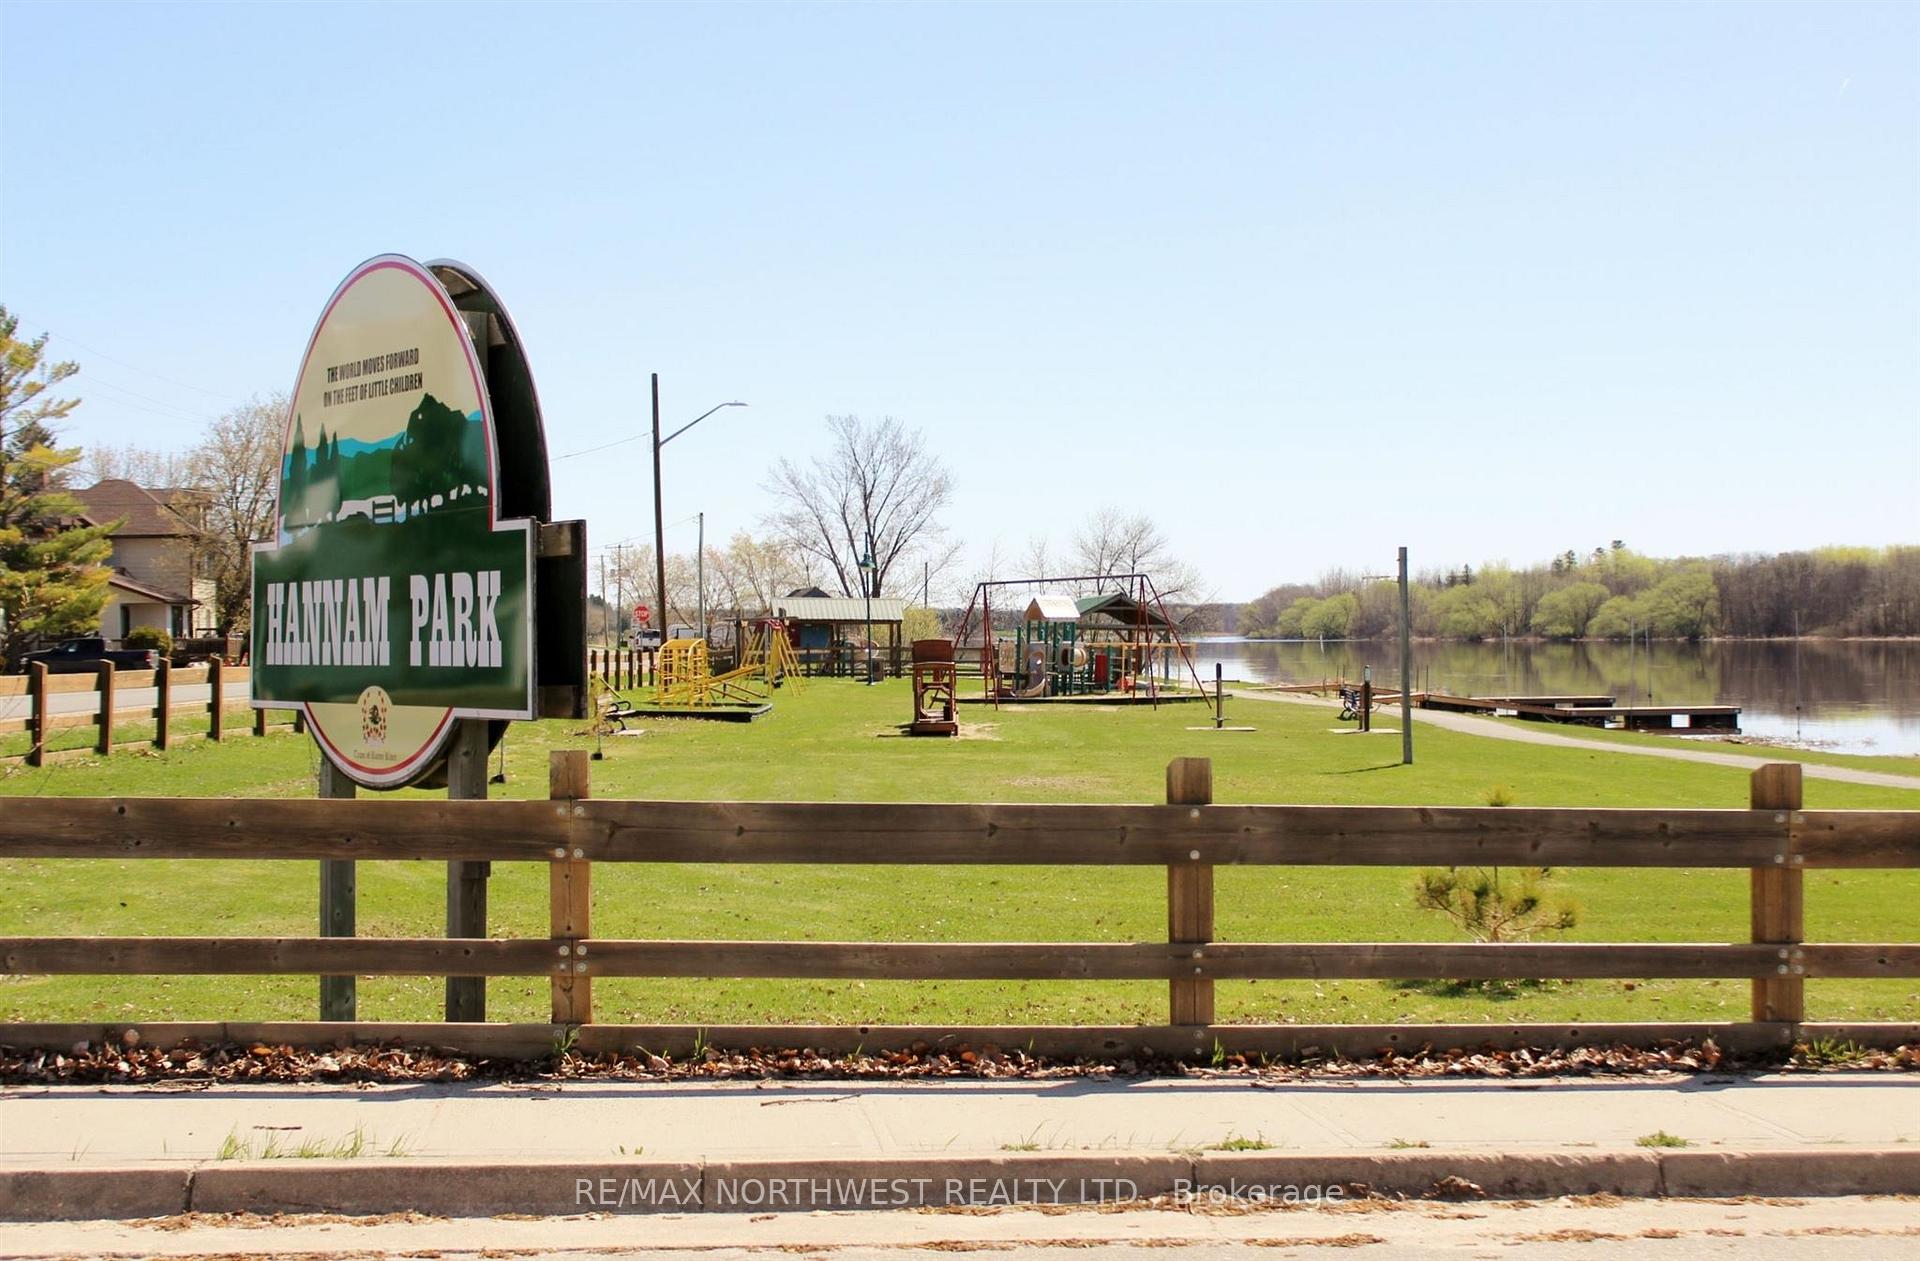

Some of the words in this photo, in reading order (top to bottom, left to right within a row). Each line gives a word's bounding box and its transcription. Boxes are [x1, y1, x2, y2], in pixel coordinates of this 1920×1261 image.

[327, 366, 338, 383] THE
[339, 360, 361, 381] WORLD
[362, 355, 385, 376] MOVES
[385, 347, 419, 371] FORWARD
[323, 391, 332, 408] ON
[333, 388, 344, 406] THE
[345, 385, 359, 403] FEET
[360, 383, 368, 401] OF
[368, 378, 389, 399] LITTLE
[389, 371, 423, 395] CHILDREN
[266, 576, 391, 667] HANNAM
[410, 570, 502, 668] PARK
[633, 610, 649, 618] STOP
